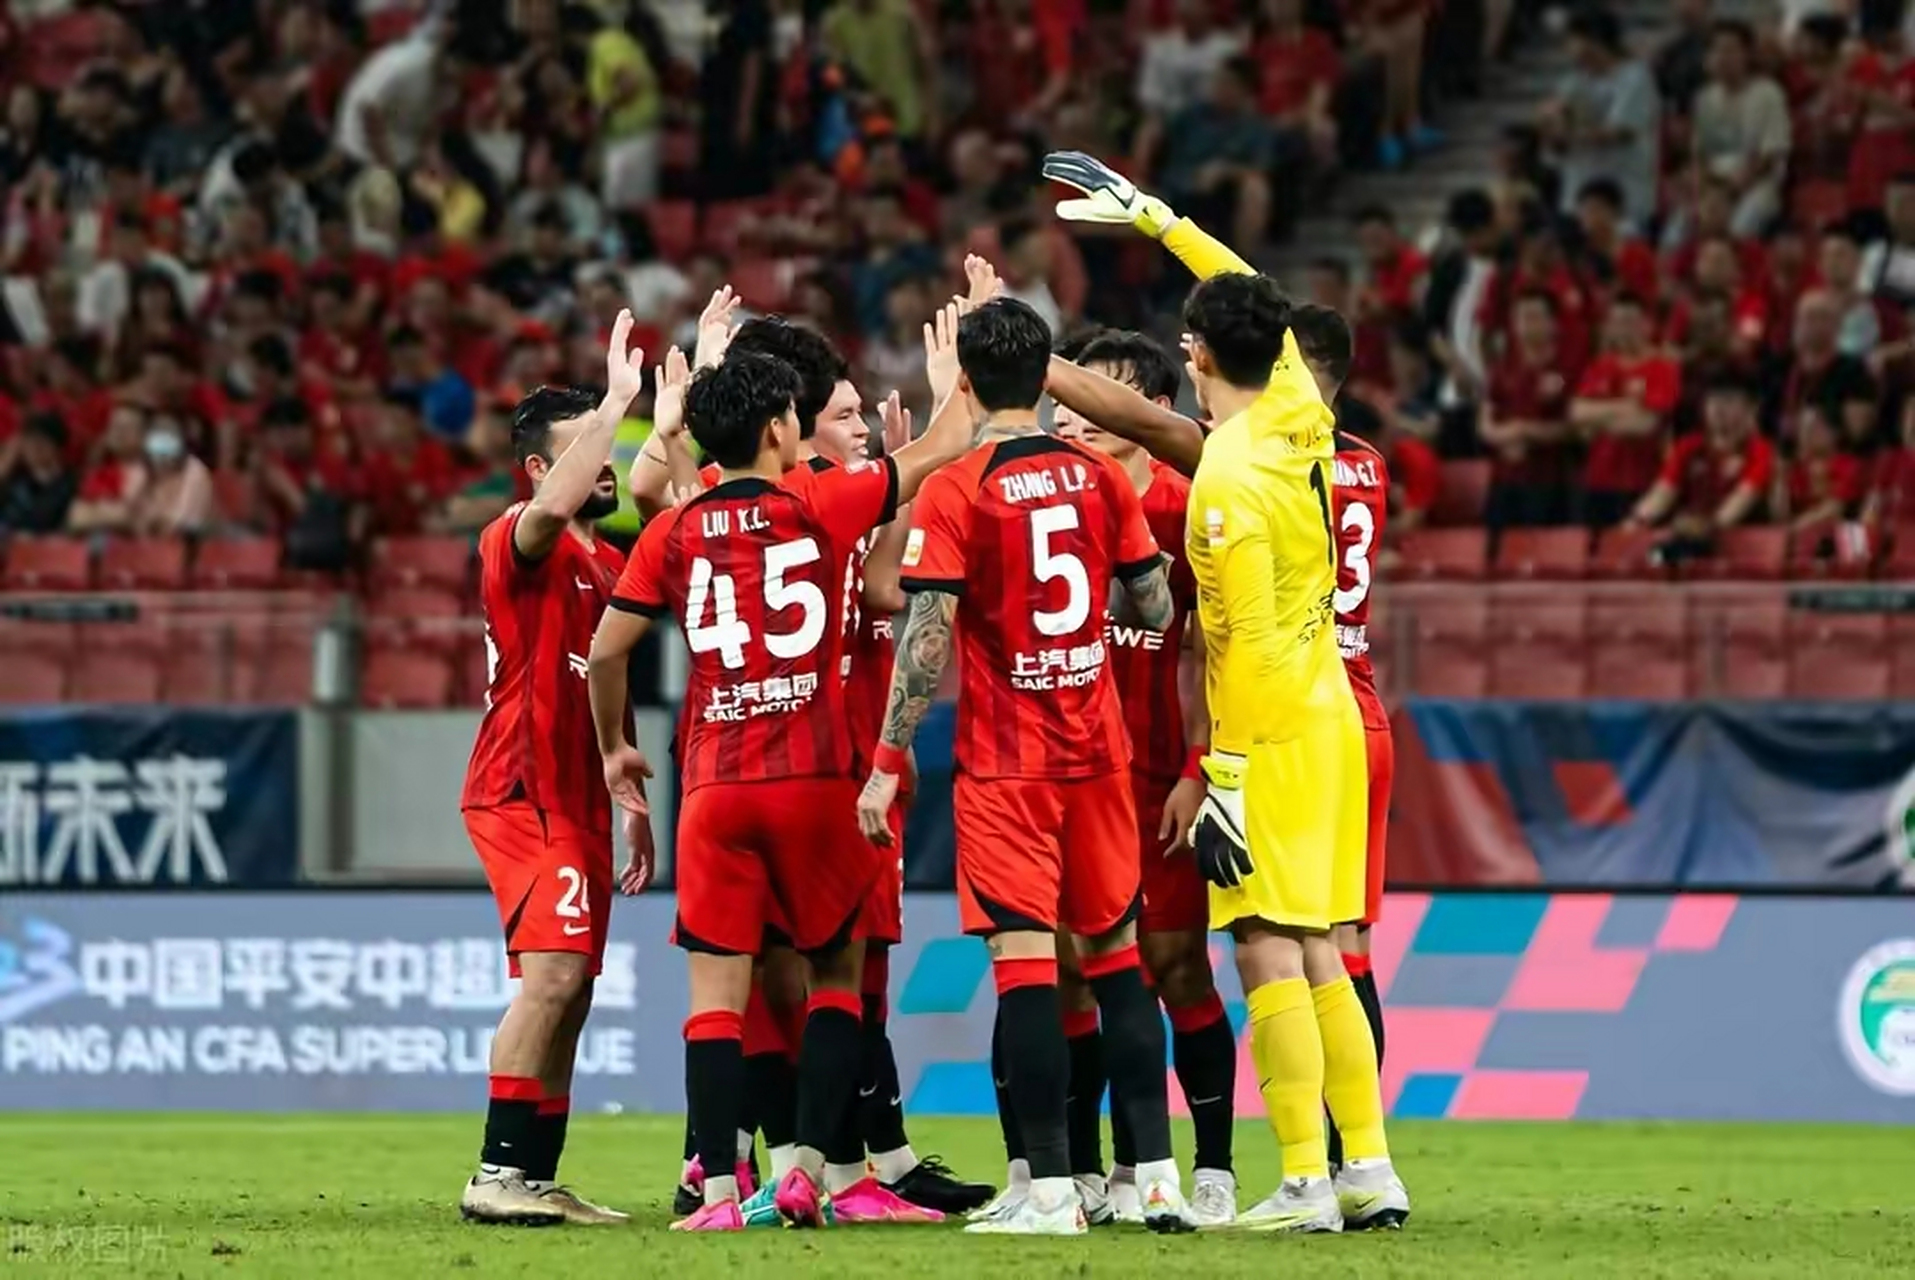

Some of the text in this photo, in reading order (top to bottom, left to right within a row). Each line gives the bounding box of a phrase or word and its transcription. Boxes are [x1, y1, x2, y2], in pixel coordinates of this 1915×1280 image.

[998, 469, 1057, 504] ZHANG
[702, 510, 729, 538] LIU
[1030, 504, 1090, 636] 5
[685, 537, 827, 669] 45
[1010, 640, 1106, 677] 上汽集团
[704, 672, 818, 711] 上汽集团
[1011, 675, 1055, 690] SAIC
[702, 708, 747, 723] SAIC
[3, 1024, 637, 1074] PING AN CFA SUPER LUE
